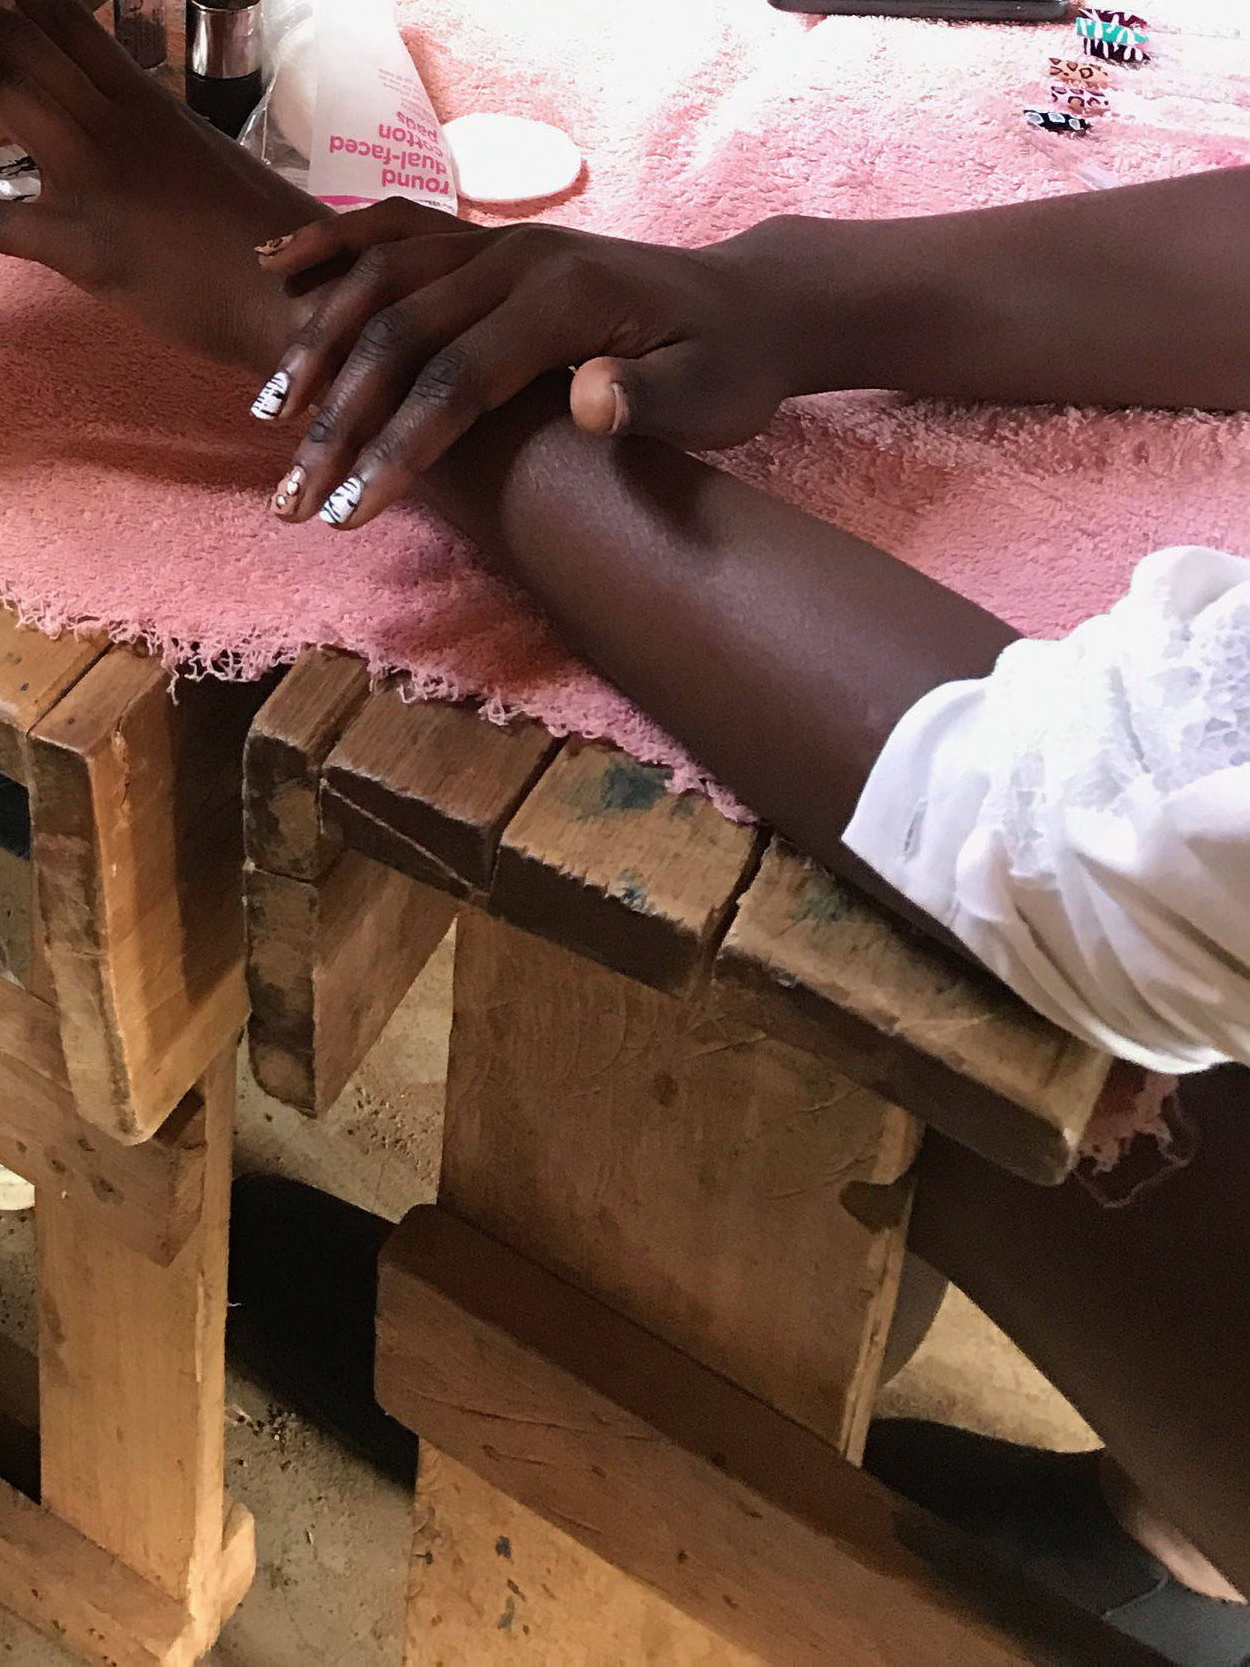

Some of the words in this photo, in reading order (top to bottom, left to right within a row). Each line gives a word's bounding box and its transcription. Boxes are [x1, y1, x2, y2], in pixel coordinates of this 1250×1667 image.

[378, 123, 444, 158] cotton
[396, 110, 438, 144] pads
[329, 135, 447, 175] dual-faced
[381, 168, 449, 195] round
